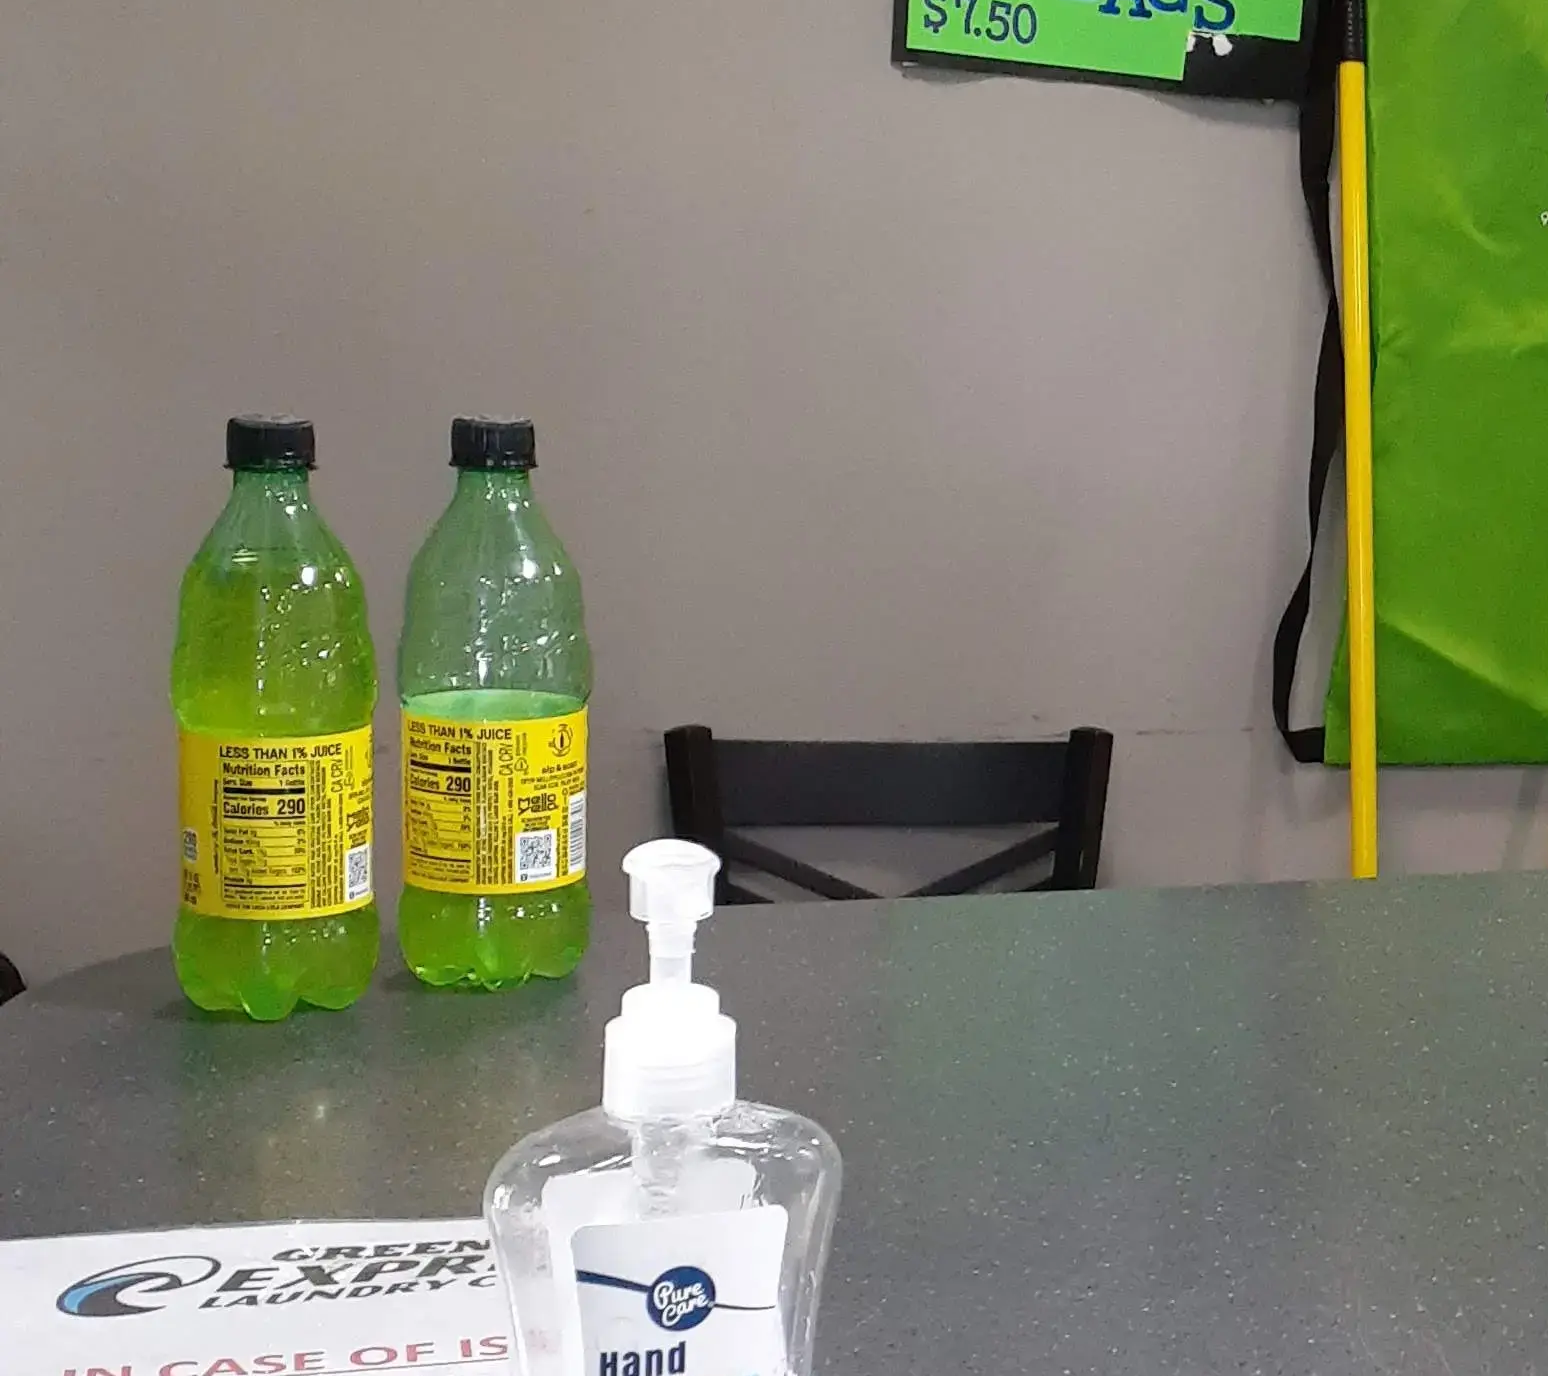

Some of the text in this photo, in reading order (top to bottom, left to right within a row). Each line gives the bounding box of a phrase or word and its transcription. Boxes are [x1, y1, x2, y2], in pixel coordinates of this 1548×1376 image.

[427, 724, 456, 738] THAN
[476, 727, 513, 741] JUICE
[219, 745, 249, 759] LESS
[252, 747, 288, 760] THAN
[311, 743, 342, 759] JUICE
[444, 741, 472, 755] Facts
[222, 762, 306, 777] Nutrition Facts
[445, 775, 472, 793] 290
[222, 801, 270, 816] Calories
[276, 797, 306, 816] 290
[272, 1239, 491, 1262] GREEN
[215, 1254, 498, 1293] EXPR
[198, 1277, 458, 1310] LAUNDRY
[653, 1280, 706, 1311] Pure
[349, 1342, 435, 1366] OF
